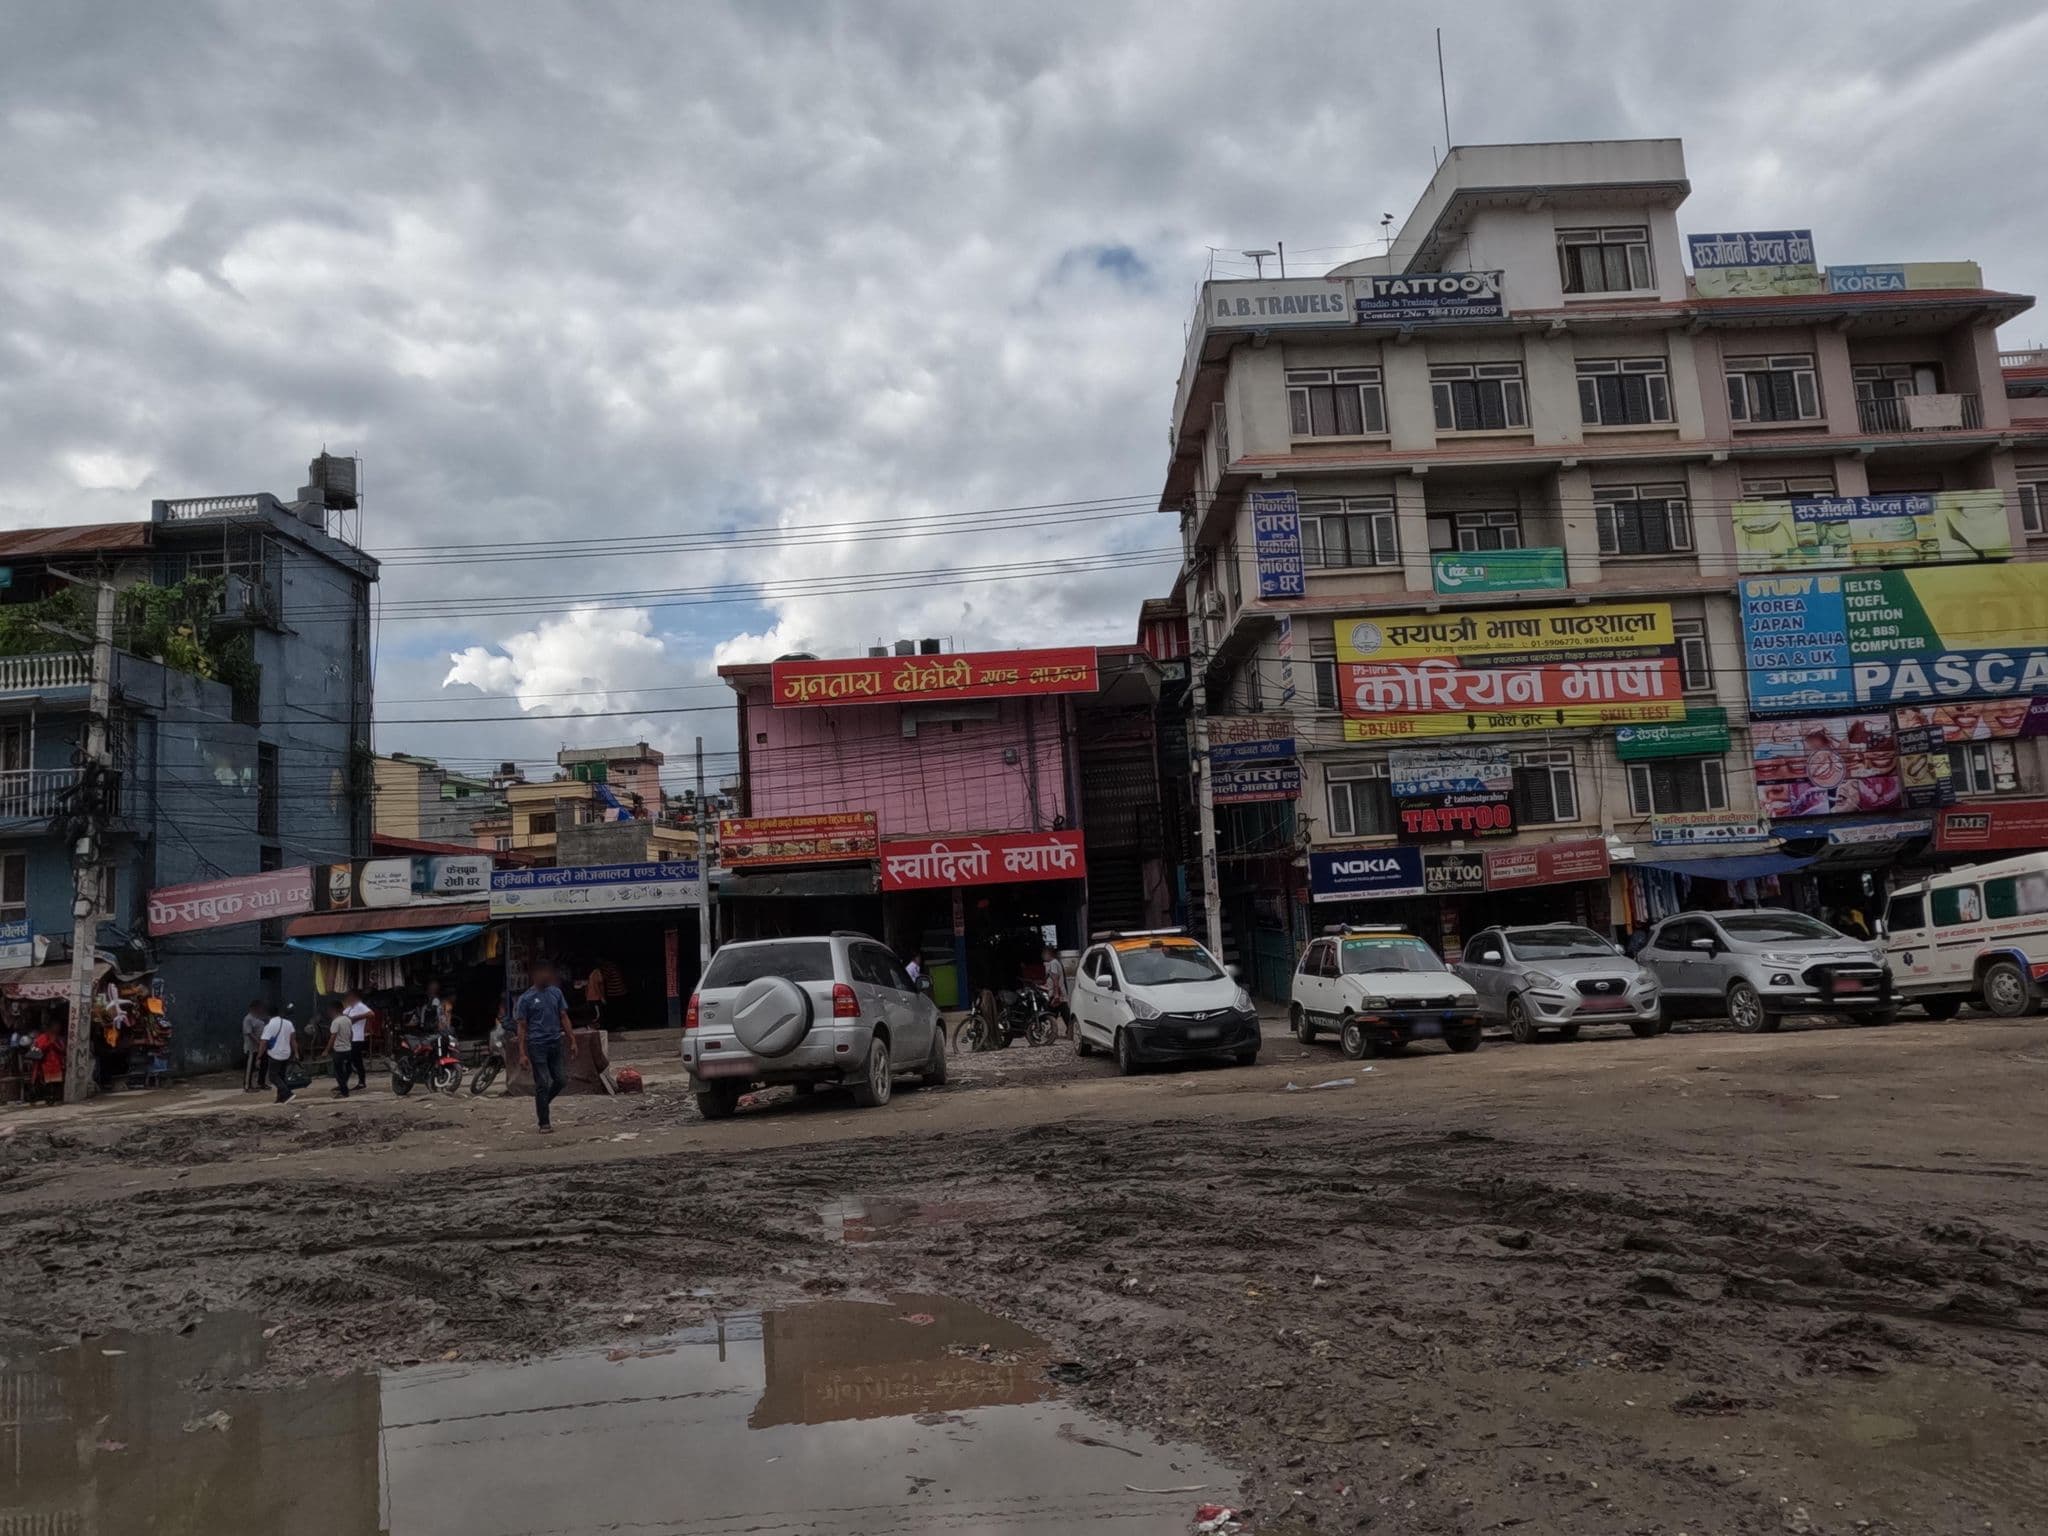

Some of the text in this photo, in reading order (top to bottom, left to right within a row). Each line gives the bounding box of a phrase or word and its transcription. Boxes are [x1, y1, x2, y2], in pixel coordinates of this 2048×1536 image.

[1374, 277, 1481, 296] TATTOO
[1833, 275, 1905, 292] KOREA
[1746, 577, 1814, 598] STUDY
[1844, 579, 1883, 593] IELTS
[1749, 598, 1808, 615] KOREA
[1846, 594, 1890, 608] TOEFL
[1750, 615, 1805, 632] JAPAN
[1847, 608, 1904, 623] TUITION
[1386, 612, 1657, 646] सयपत्री भाषा पाठशाला
[1849, 625, 1900, 641] (+2, BBS)
[1752, 631, 1847, 651] AUSTRALIA
[1851, 637, 1926, 653] COMPUTER
[1754, 649, 1836, 669] USA & UK
[891, 658, 973, 692] दोहोरी
[1353, 658, 1665, 712] कोरियन भाषा
[1640, 705, 1671, 719] TEST
[1401, 804, 1512, 833] TATTOO
[886, 837, 1079, 884] स्वादिलो क्याफे
[1331, 857, 1401, 876] NOKIA
[466, 876, 481, 886] घर
[149, 892, 244, 923] फेसबुक
[246, 889, 281, 909] रोधी
